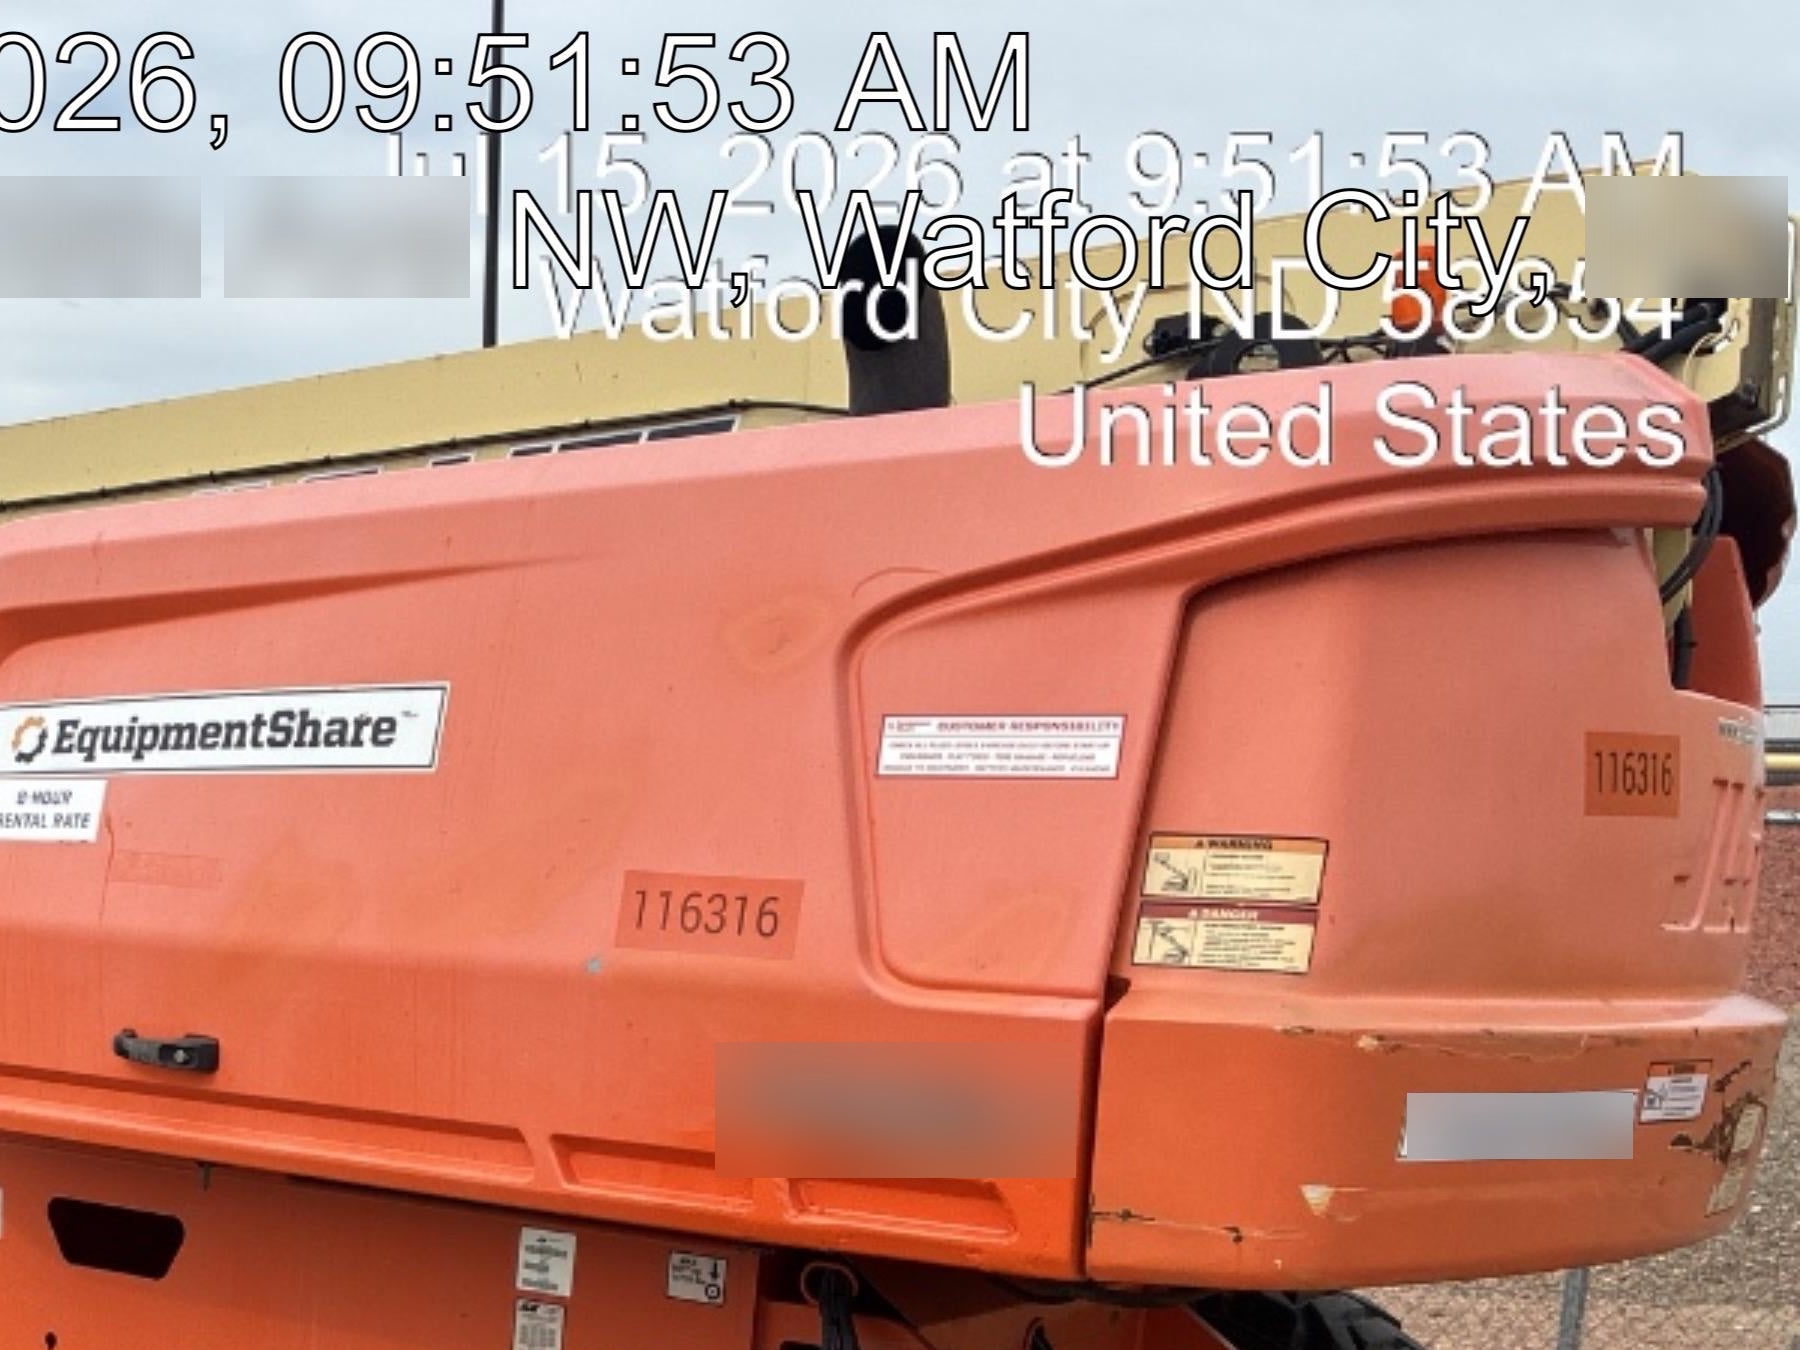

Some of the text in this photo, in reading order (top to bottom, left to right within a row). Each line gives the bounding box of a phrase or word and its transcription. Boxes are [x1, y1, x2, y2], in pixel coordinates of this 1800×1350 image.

[51, 708, 398, 763] EquipmentShare
[1593, 750, 1674, 796] 116316
[53, 812, 92, 829] RATE
[634, 889, 780, 939] 116316
